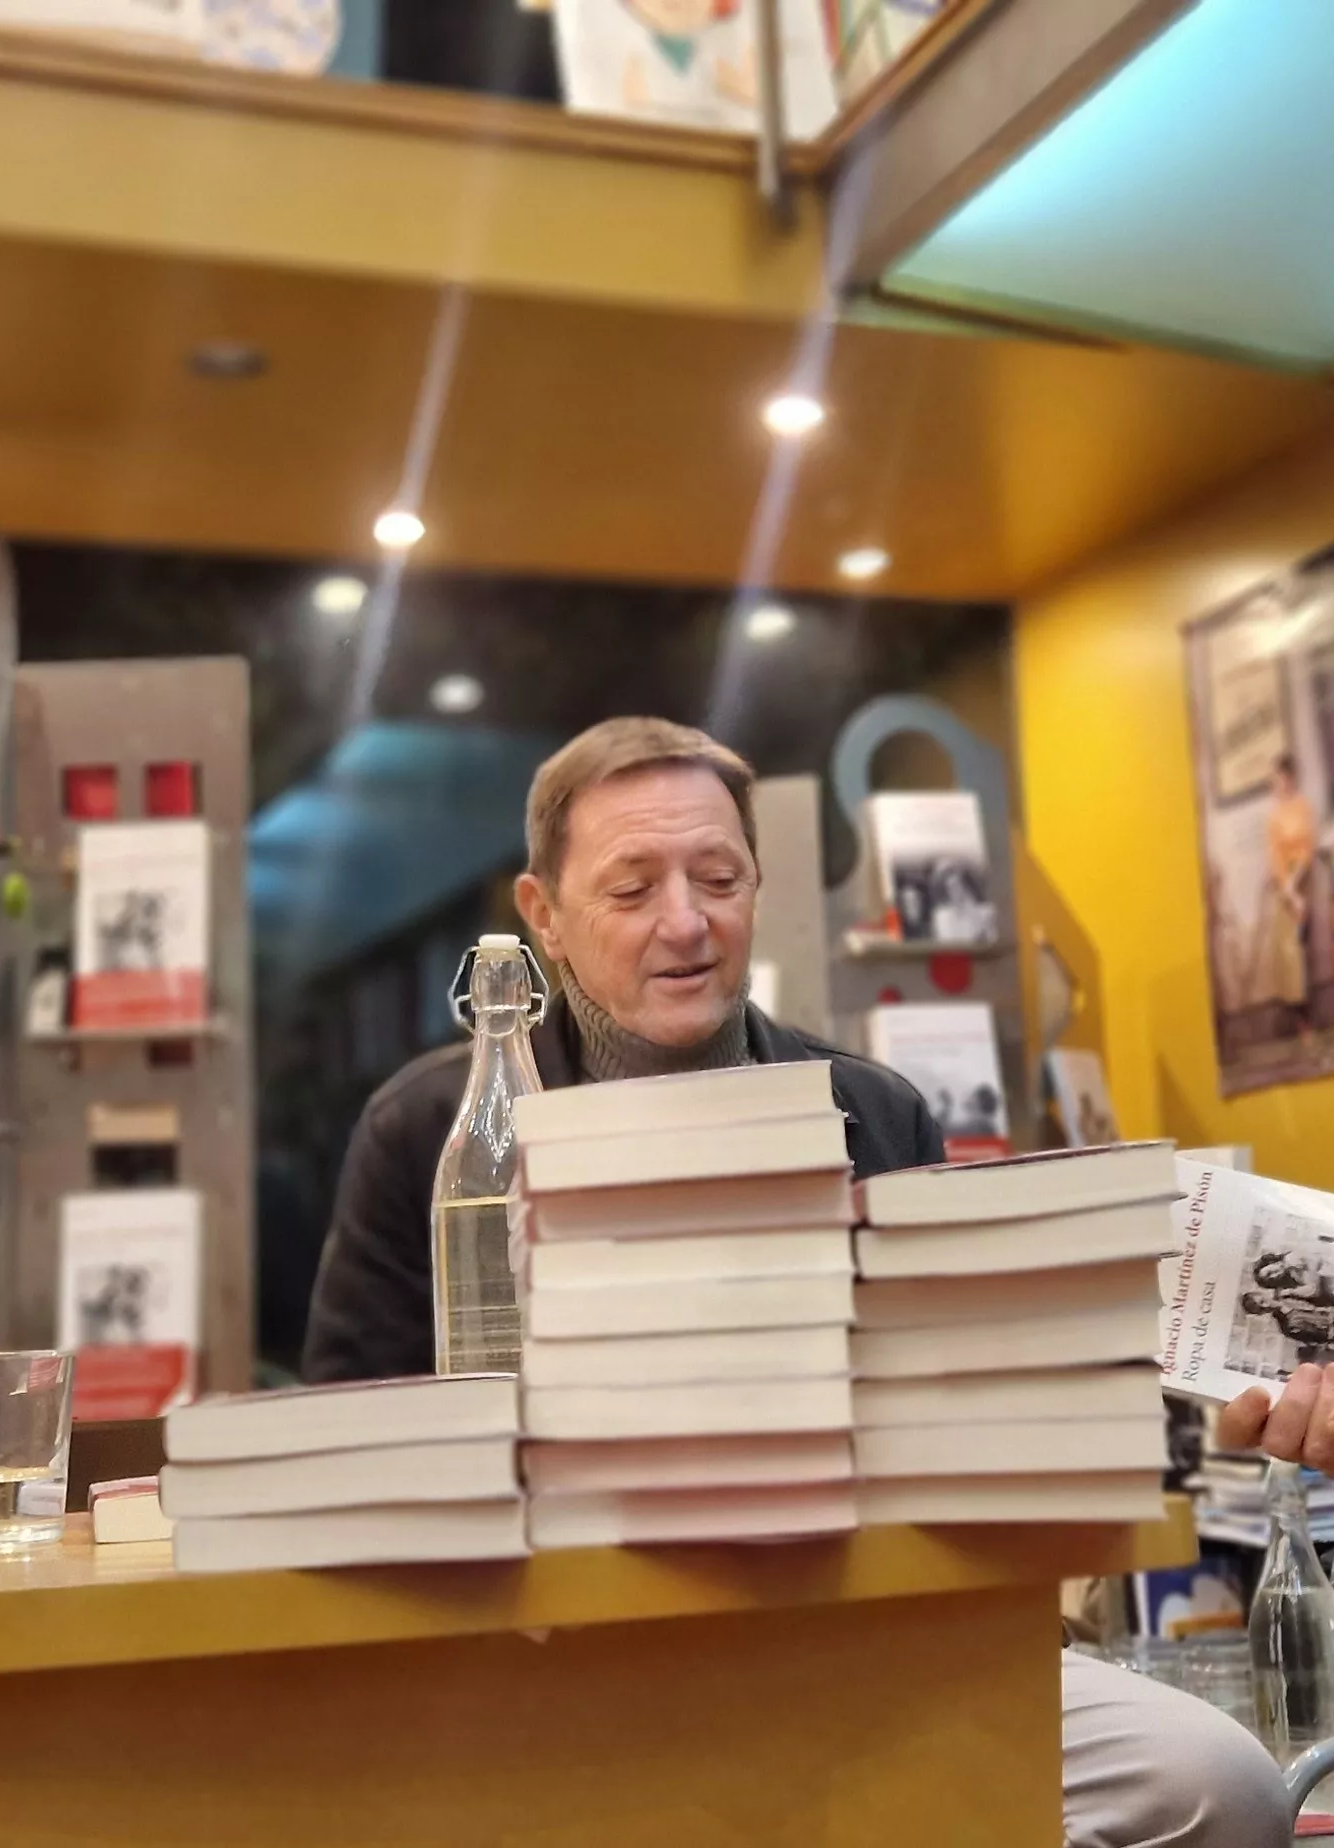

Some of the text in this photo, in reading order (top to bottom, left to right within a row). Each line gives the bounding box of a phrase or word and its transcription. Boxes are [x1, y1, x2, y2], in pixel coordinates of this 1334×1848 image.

[1190, 1169, 1213, 1214] Pisón
[1186, 1216, 1203, 1238] de
[1170, 1241, 1199, 1314] Martínez
[1181, 1280, 1216, 1383] Ropa de casa
